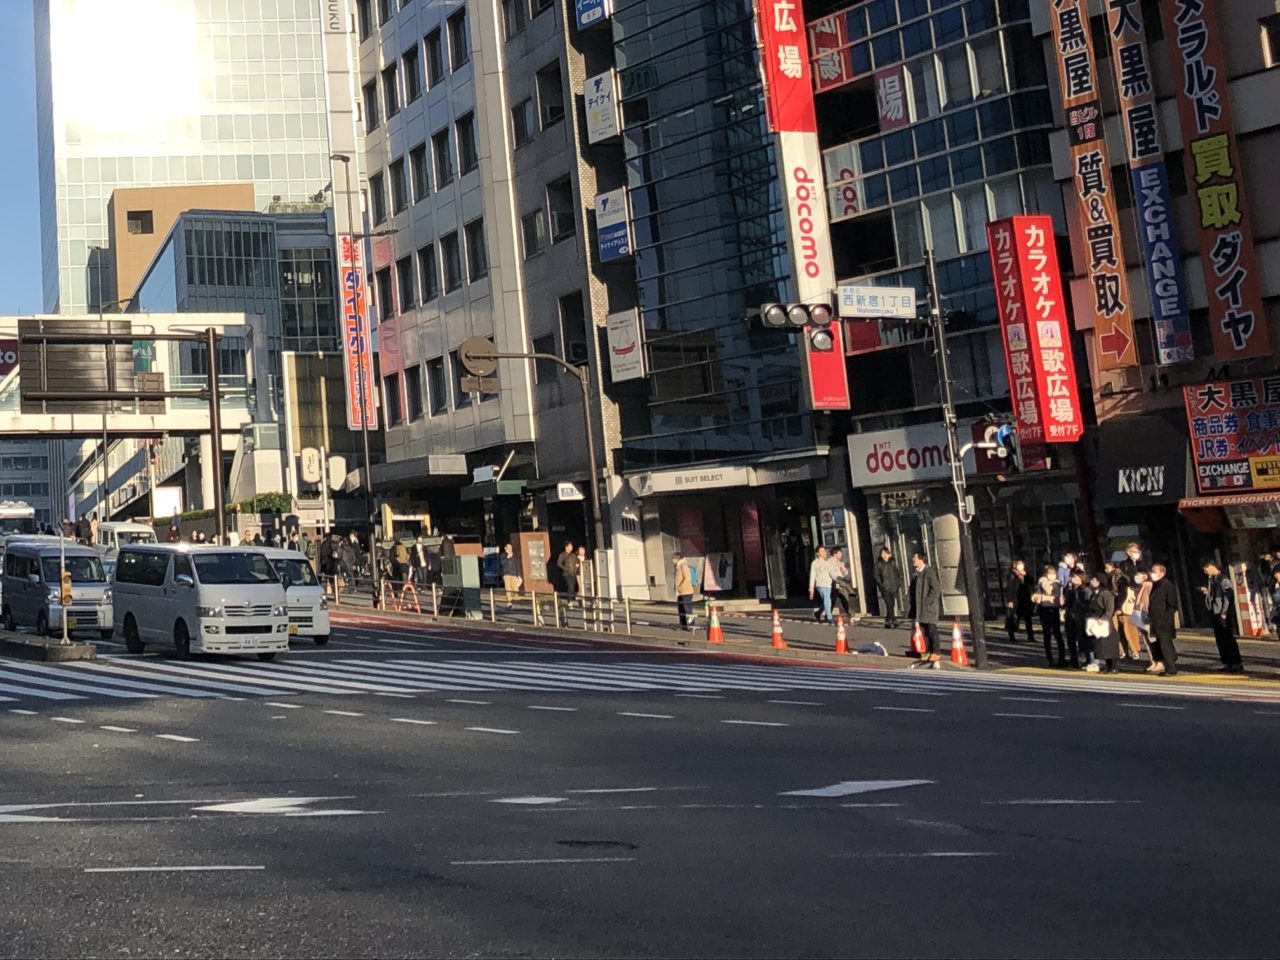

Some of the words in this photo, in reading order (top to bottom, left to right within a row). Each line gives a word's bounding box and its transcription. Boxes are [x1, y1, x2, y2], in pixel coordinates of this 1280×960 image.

[1189, 133, 1242, 229] 買取
[793, 166, 821, 280] docomo
[1076, 151, 1127, 319] 質&買取
[1139, 167, 1181, 316] EXCHANGE
[843, 294, 912, 308] 西新宿1丁目
[1210, 230, 1255, 350] ダイヤ
[994, 228, 1021, 321] カラオケ
[1011, 349, 1039, 425] 歌広場
[1024, 224, 1056, 319] カラオケ
[1040, 348, 1075, 424] 歌広場
[1197, 375, 1280, 413] 大黒屋
[866, 443, 953, 473] docomo
[1049, 424, 1080, 438] 受付7F
[684, 475, 699, 483] SUIT
[700, 473, 724, 482] SELECT
[1181, 499, 1220, 507] TICKET
[1222, 495, 1280, 505] DAIKOKUY
[1199, 462, 1250, 477] EXCHANGE
